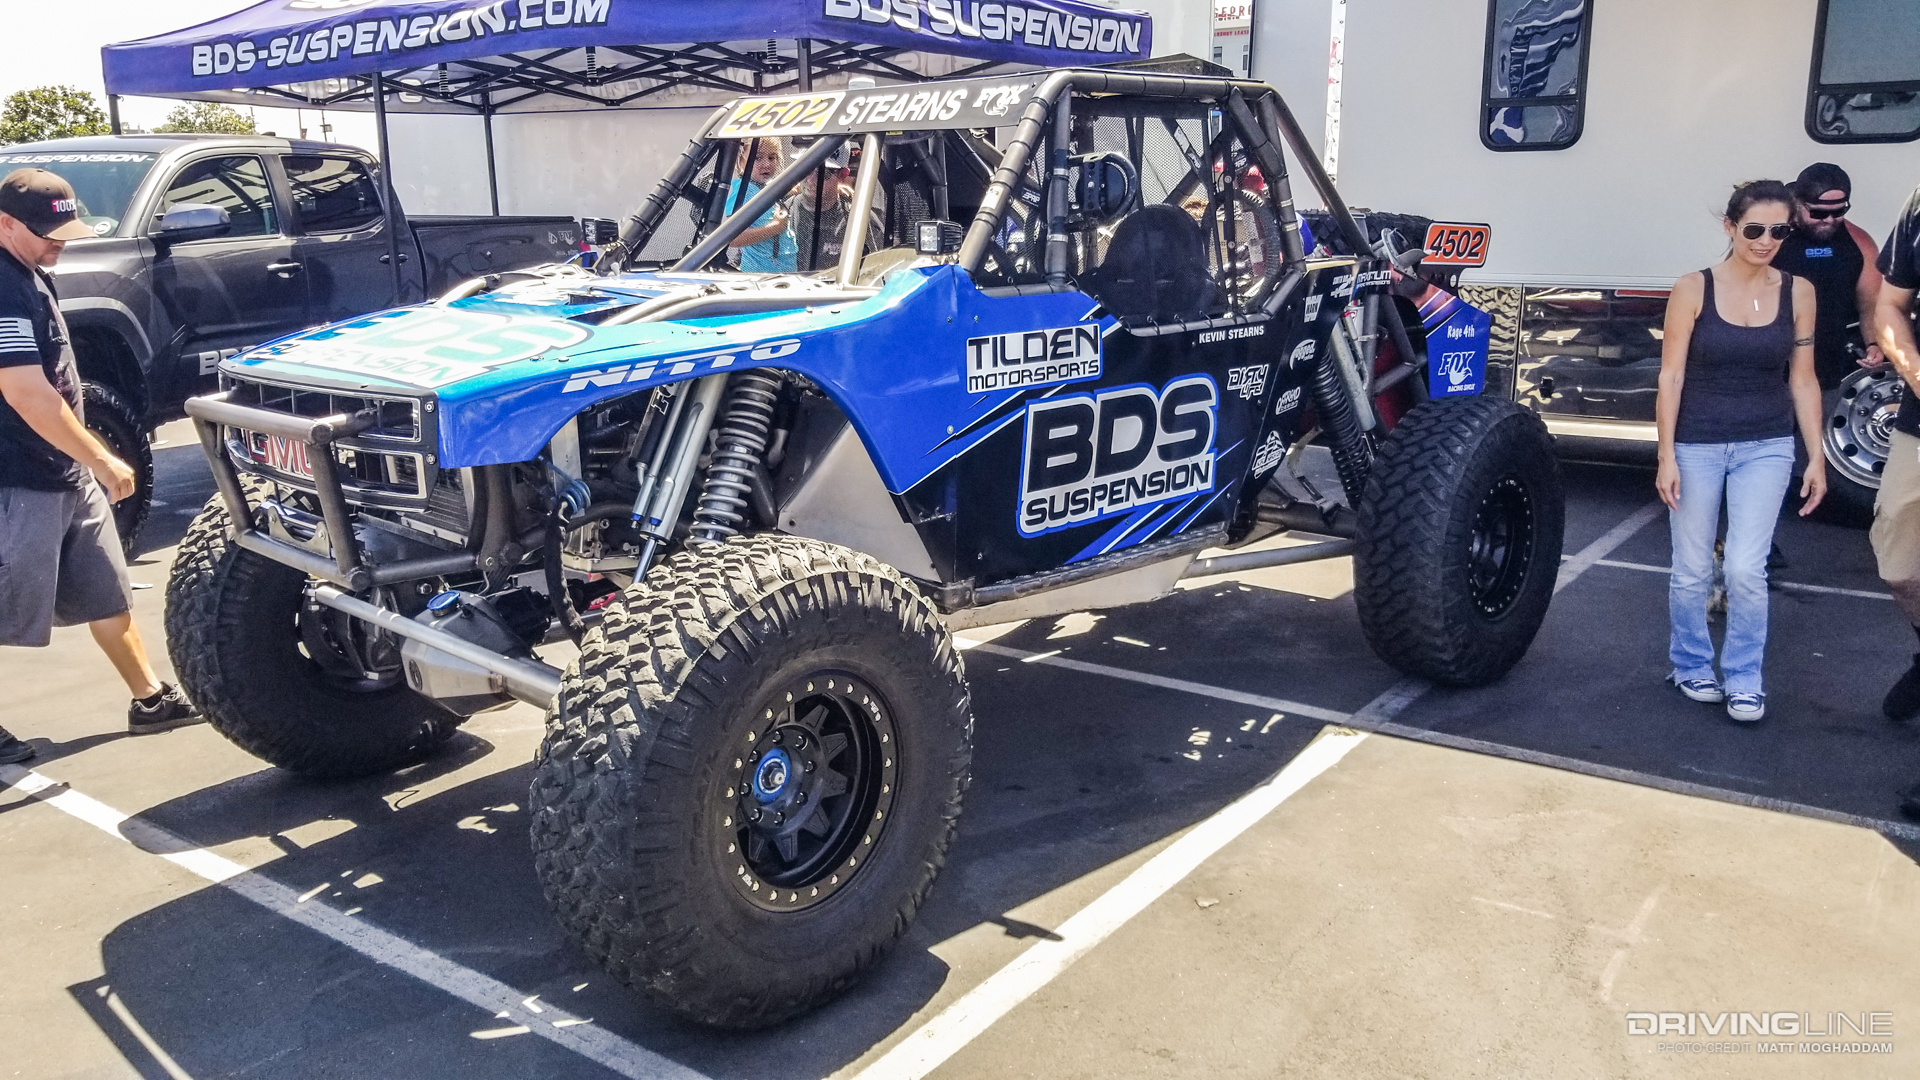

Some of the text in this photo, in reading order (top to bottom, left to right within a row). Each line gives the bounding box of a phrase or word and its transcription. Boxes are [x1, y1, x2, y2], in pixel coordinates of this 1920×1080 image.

[192, 0, 610, 76] BDS-SUSPENSION.COM
[926, 0, 1141, 53] SUSPENSION
[728, 97, 837, 131] 4502
[838, 89, 967, 126] STEARNS
[972, 84, 1029, 110] FOX
[1430, 229, 1485, 259] 4502
[968, 325, 1099, 370] TILDEN
[1199, 325, 1264, 344] KEVIN STEARNS
[1447, 325, 1475, 339] Rage 4th
[562, 338, 801, 393] NITTO
[968, 359, 1099, 392] MOTORSPORTS
[1438, 351, 1475, 377] FOX
[1027, 383, 1213, 494] BDS
[1024, 459, 1210, 527] SUSPENSION
